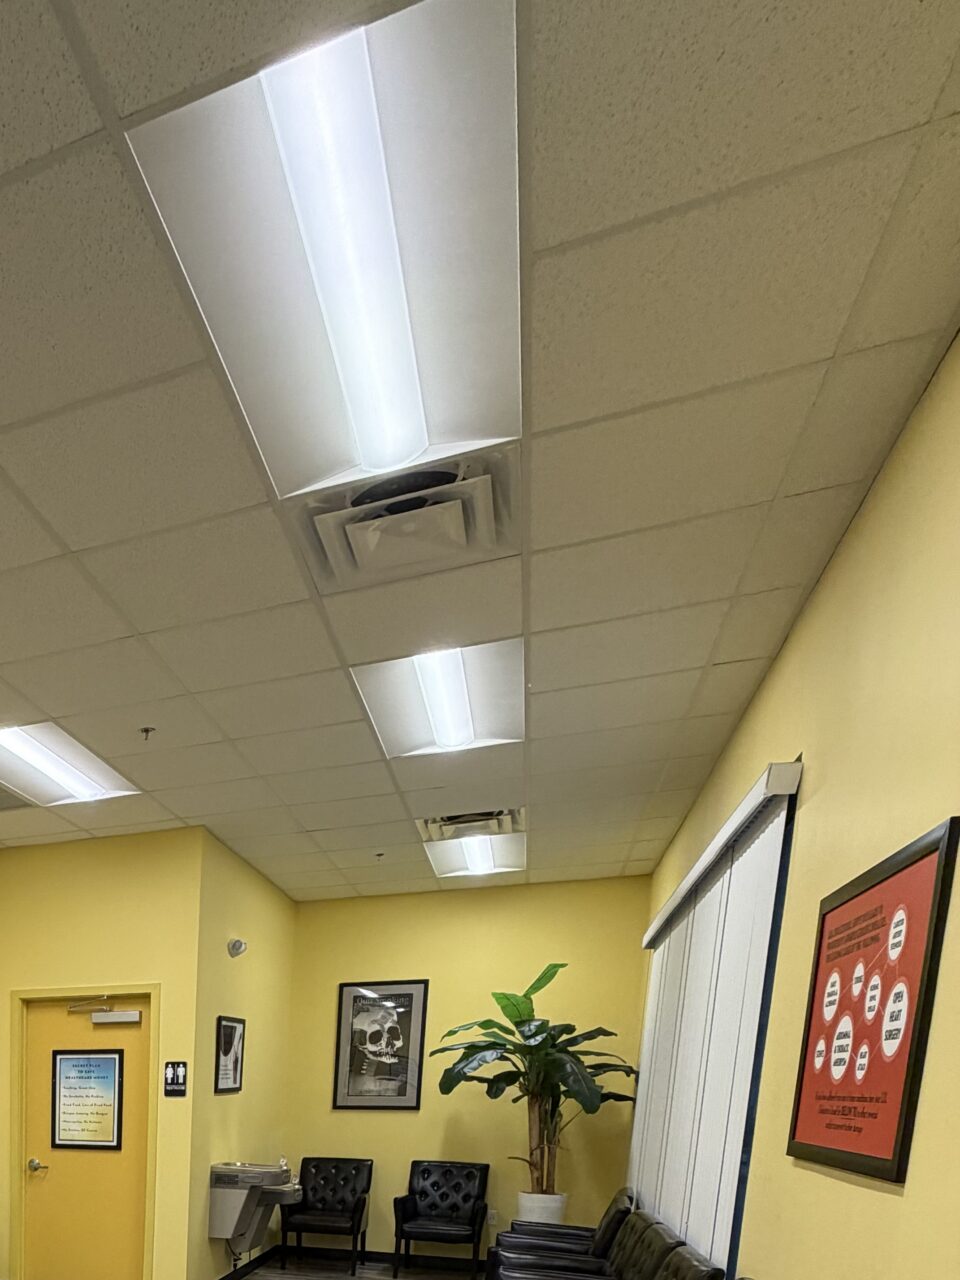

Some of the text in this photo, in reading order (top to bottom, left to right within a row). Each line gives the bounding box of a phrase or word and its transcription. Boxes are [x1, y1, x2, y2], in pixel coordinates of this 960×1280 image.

[893, 991, 904, 1004] OPEN
[890, 1009, 902, 1022] HEART
[884, 1028, 902, 1041] SURGERY
